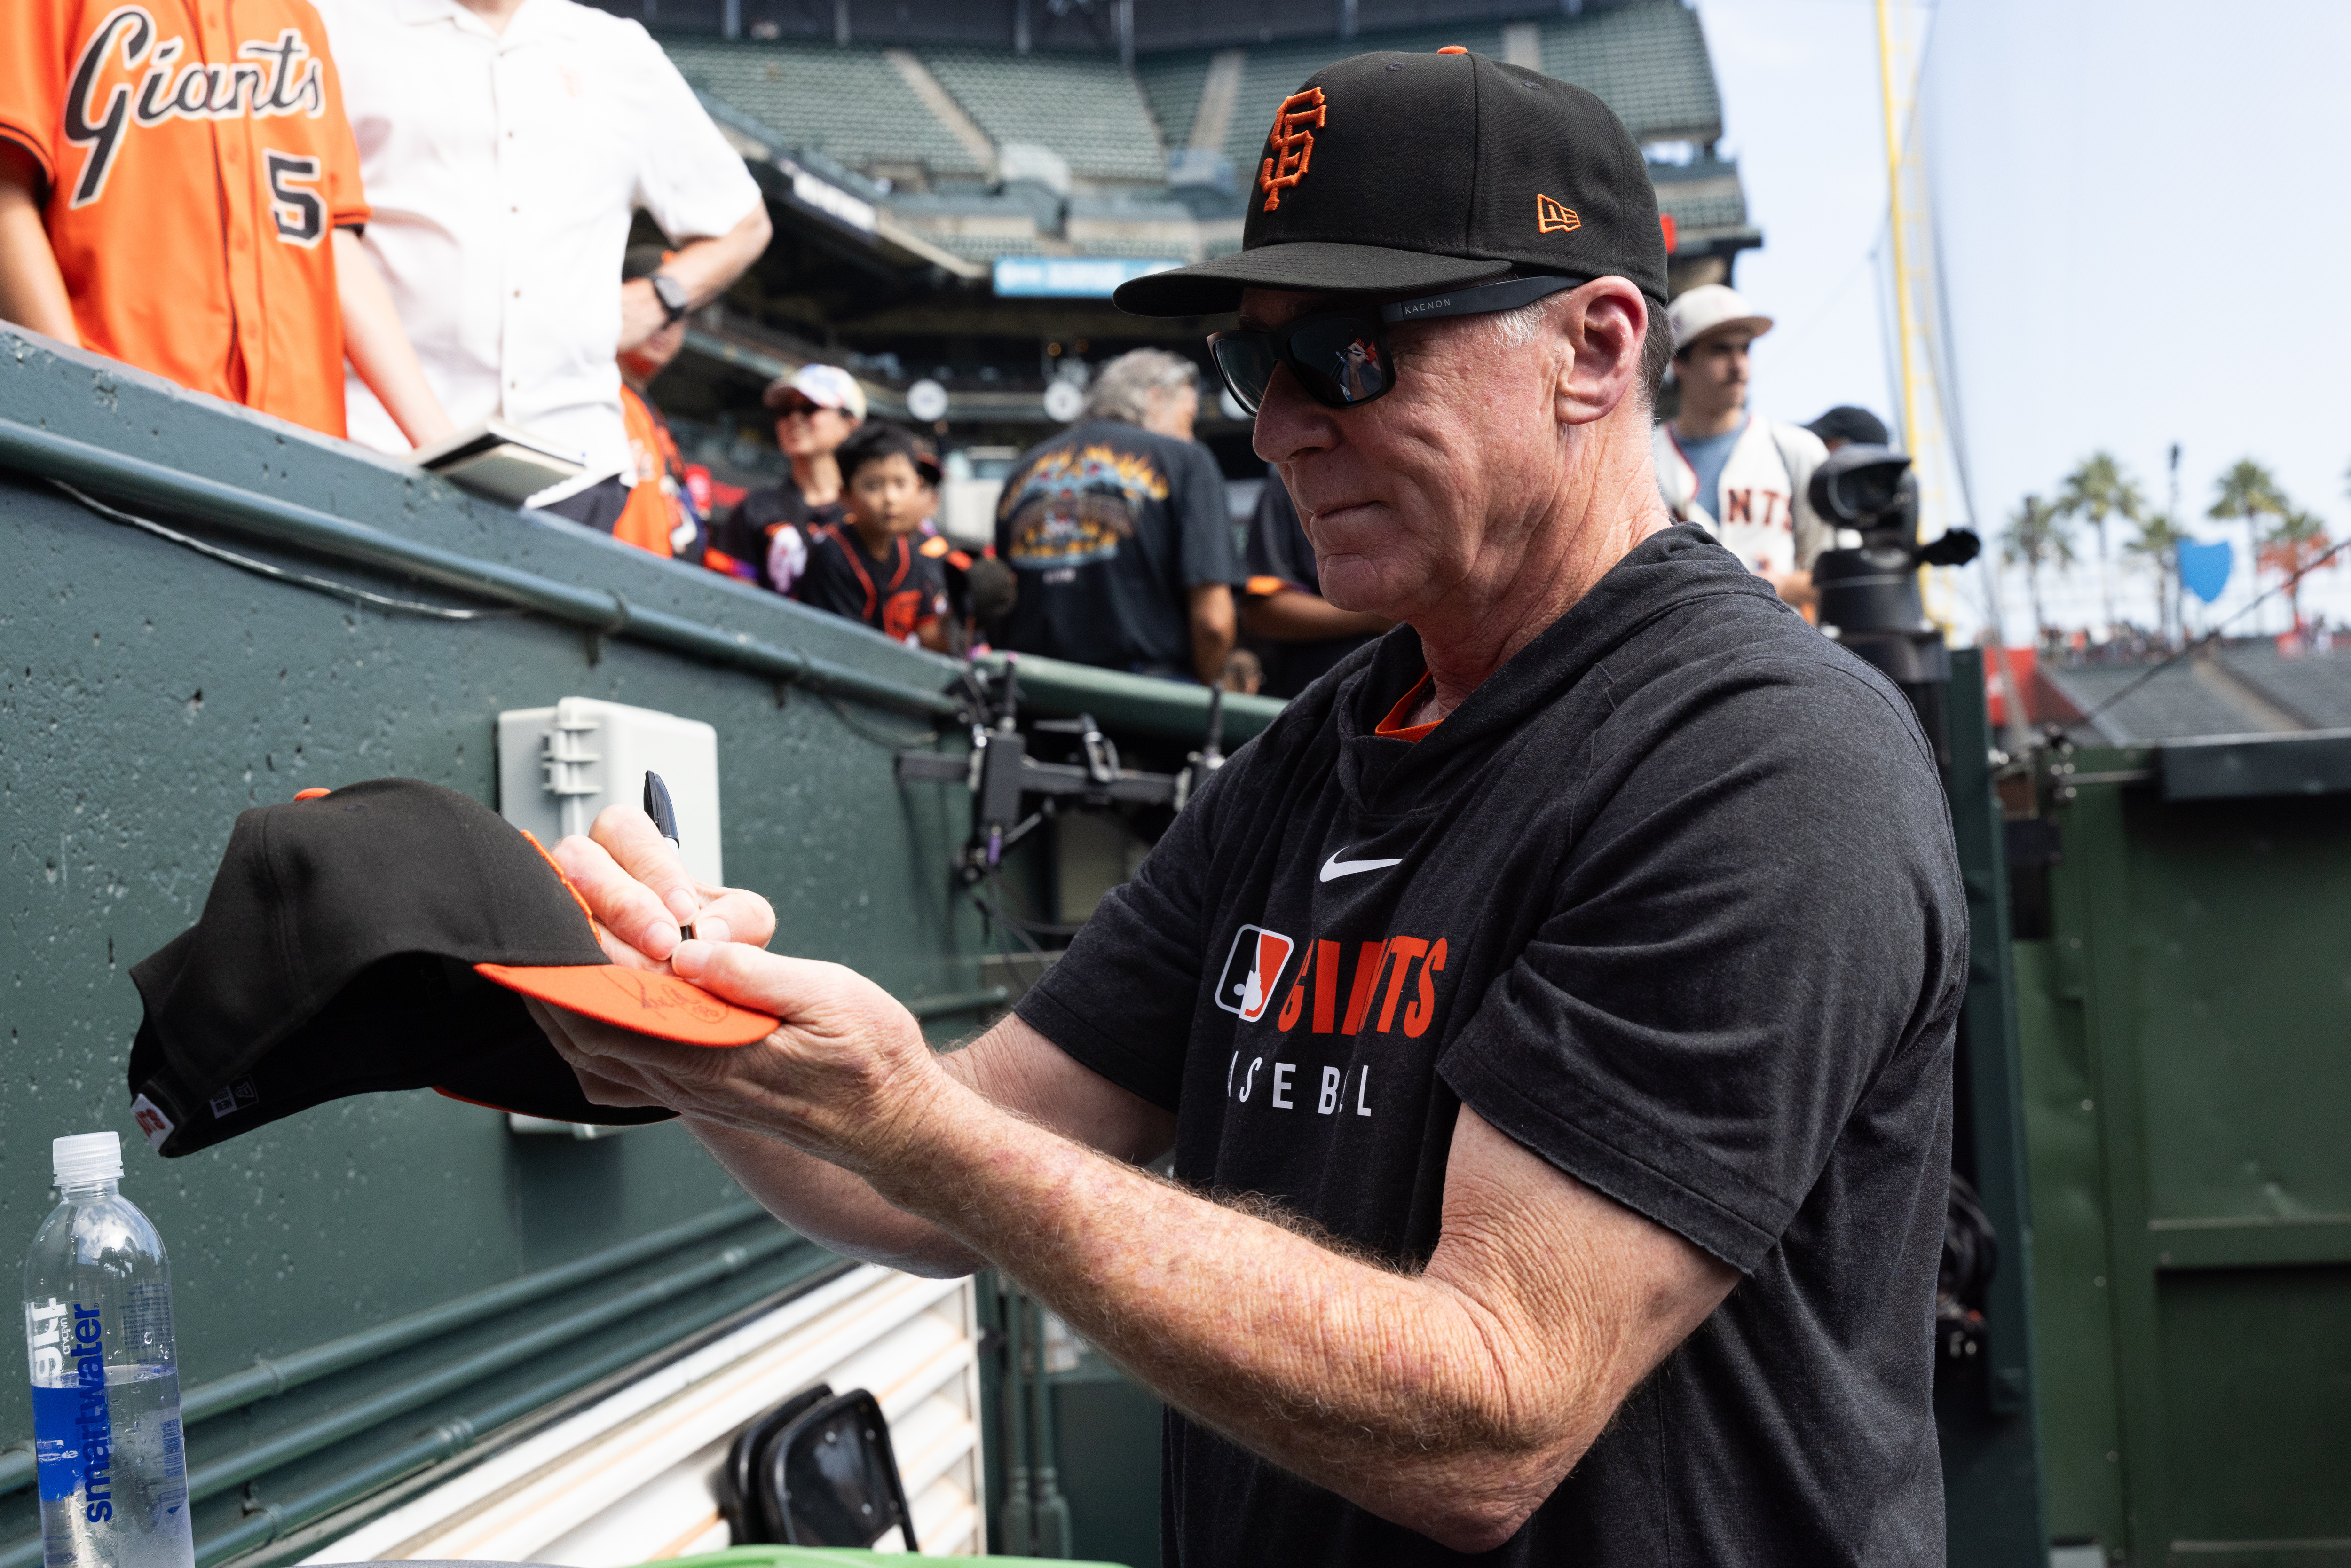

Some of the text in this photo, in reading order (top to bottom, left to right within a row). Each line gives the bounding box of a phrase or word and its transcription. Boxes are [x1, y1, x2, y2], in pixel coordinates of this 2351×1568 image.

[64, 6, 325, 210] Giants
[265, 149, 327, 248] 5
[1404, 299, 1451, 314] KAENON
[71, 1303, 112, 1523] smartwater
